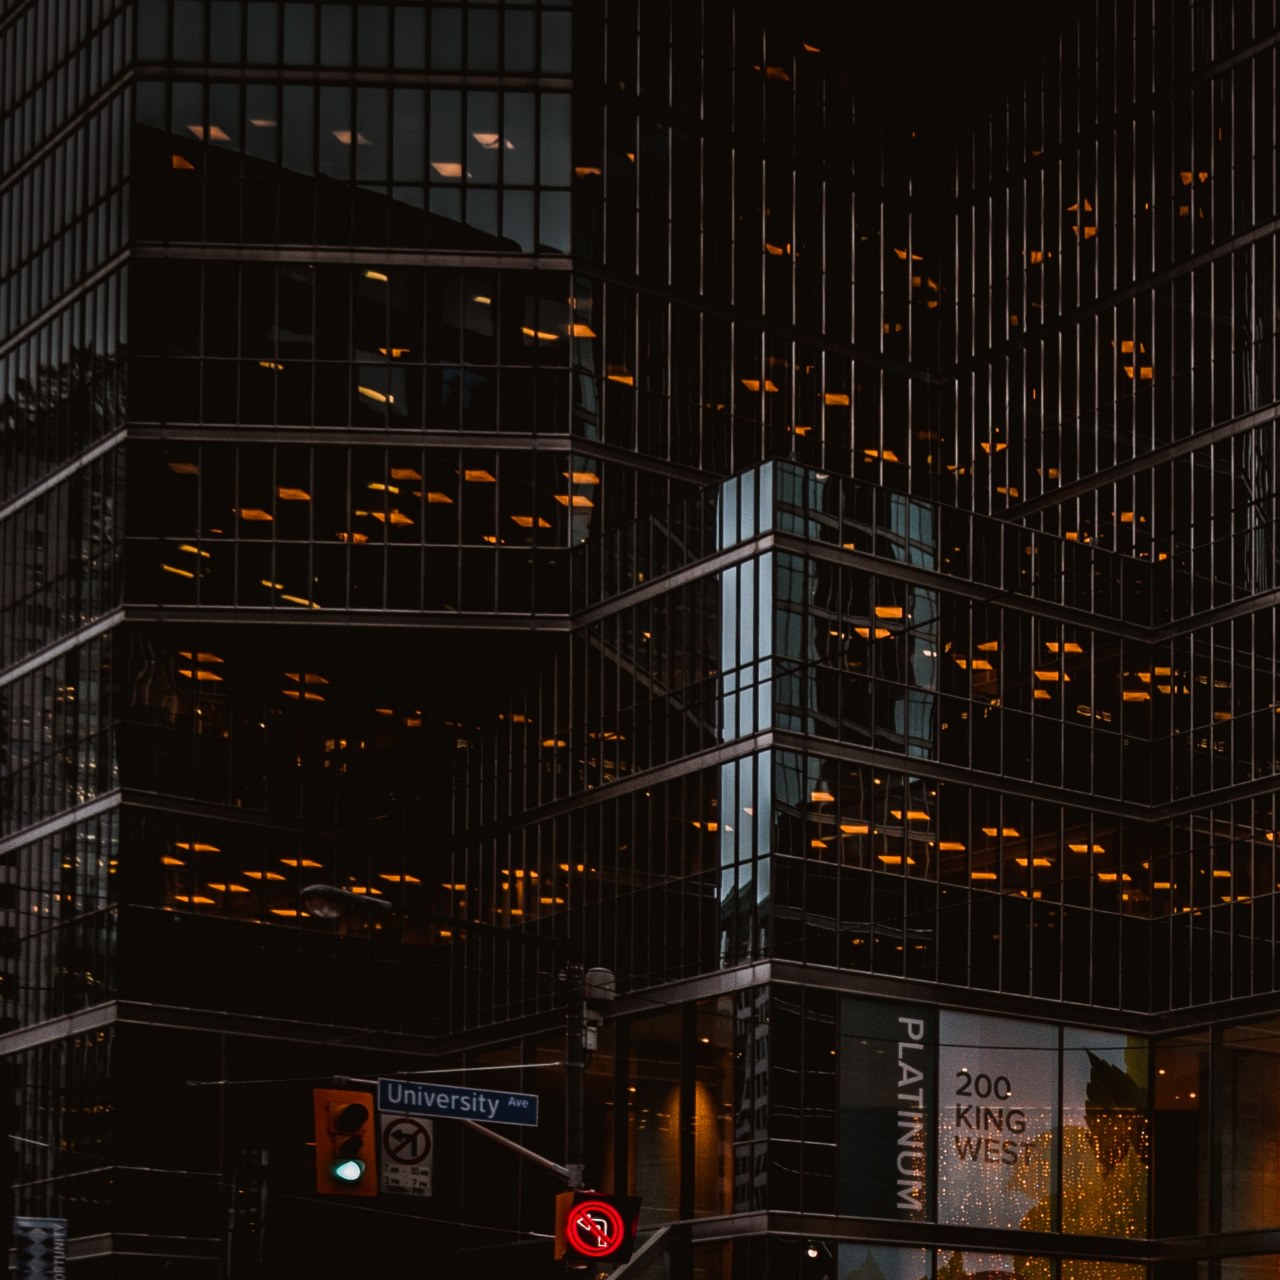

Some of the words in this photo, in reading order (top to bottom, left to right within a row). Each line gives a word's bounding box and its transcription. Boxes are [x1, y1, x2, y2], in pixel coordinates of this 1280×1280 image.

[387, 1082, 500, 1119] University
[508, 1096, 529, 1108] Ave
[955, 1071, 1012, 1101] 200
[896, 1016, 925, 1212] PLATINUM
[955, 1103, 1026, 1134] KING
[954, 1135, 1036, 1167] WEST
